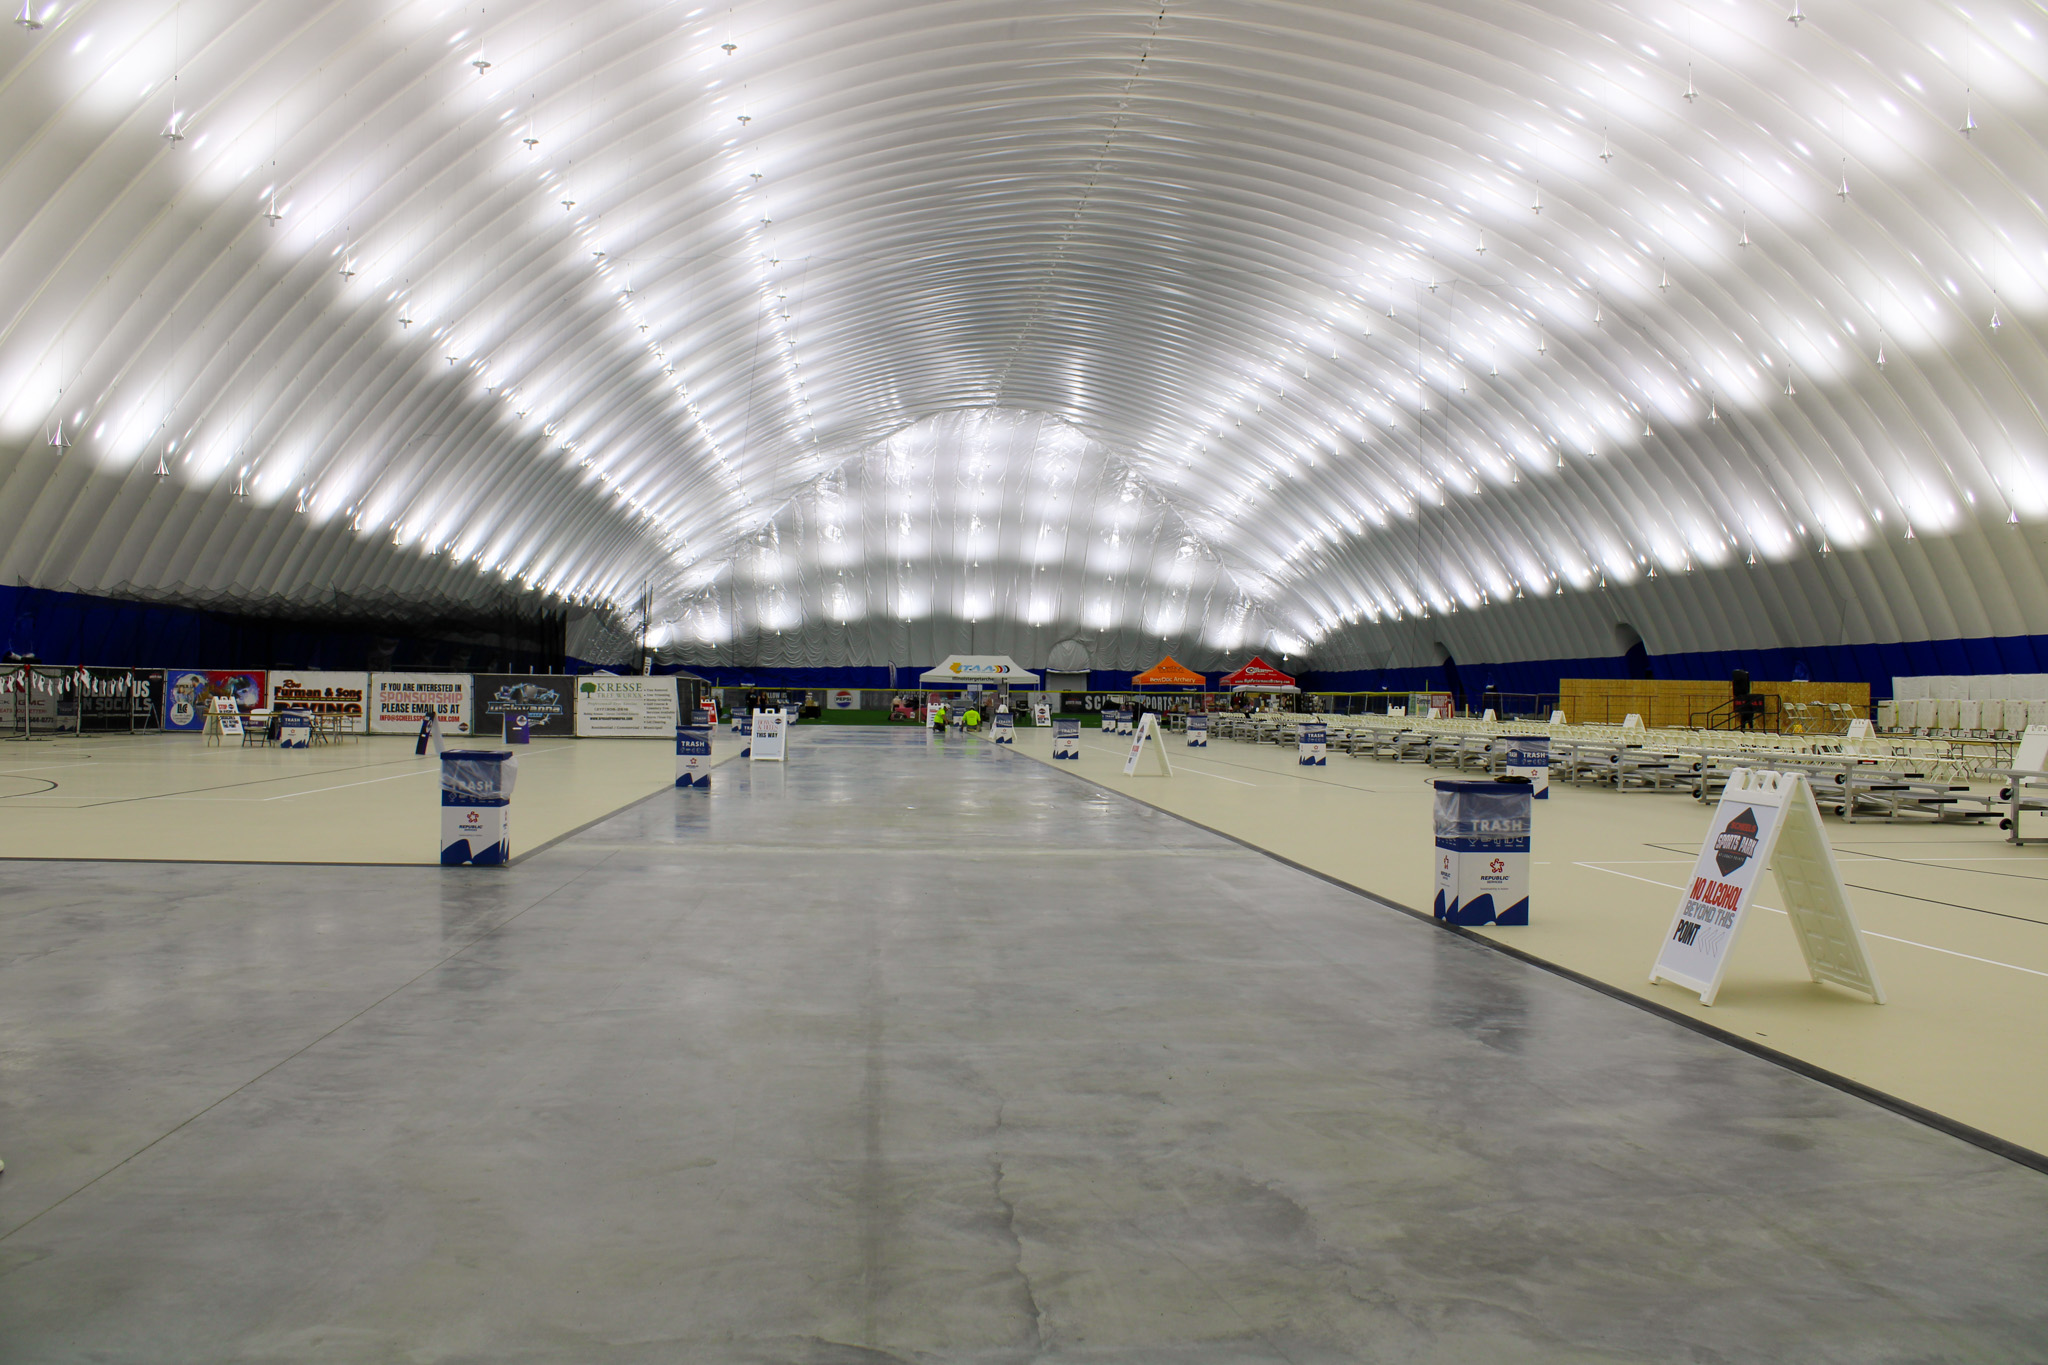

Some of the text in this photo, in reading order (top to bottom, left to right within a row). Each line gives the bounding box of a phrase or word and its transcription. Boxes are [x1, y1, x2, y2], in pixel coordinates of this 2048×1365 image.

[133, 680, 150, 698] US
[274, 686, 321, 697] Furman
[325, 687, 333, 697] &
[381, 683, 461, 692] IF YOU ARE INTERESTED IN
[597, 683, 643, 692] KRESSE
[380, 692, 463, 703] SPONSORSHIP
[382, 703, 460, 714] PLEASE EMAIL US AT
[1471, 819, 1523, 832] TRASH
[1716, 834, 1759, 857] SPORTS PARK
[1690, 877, 1742, 912] NO ALCOHOL
[1683, 900, 1735, 930] BEYOND THIS
[1673, 919, 1701, 946] POINT
